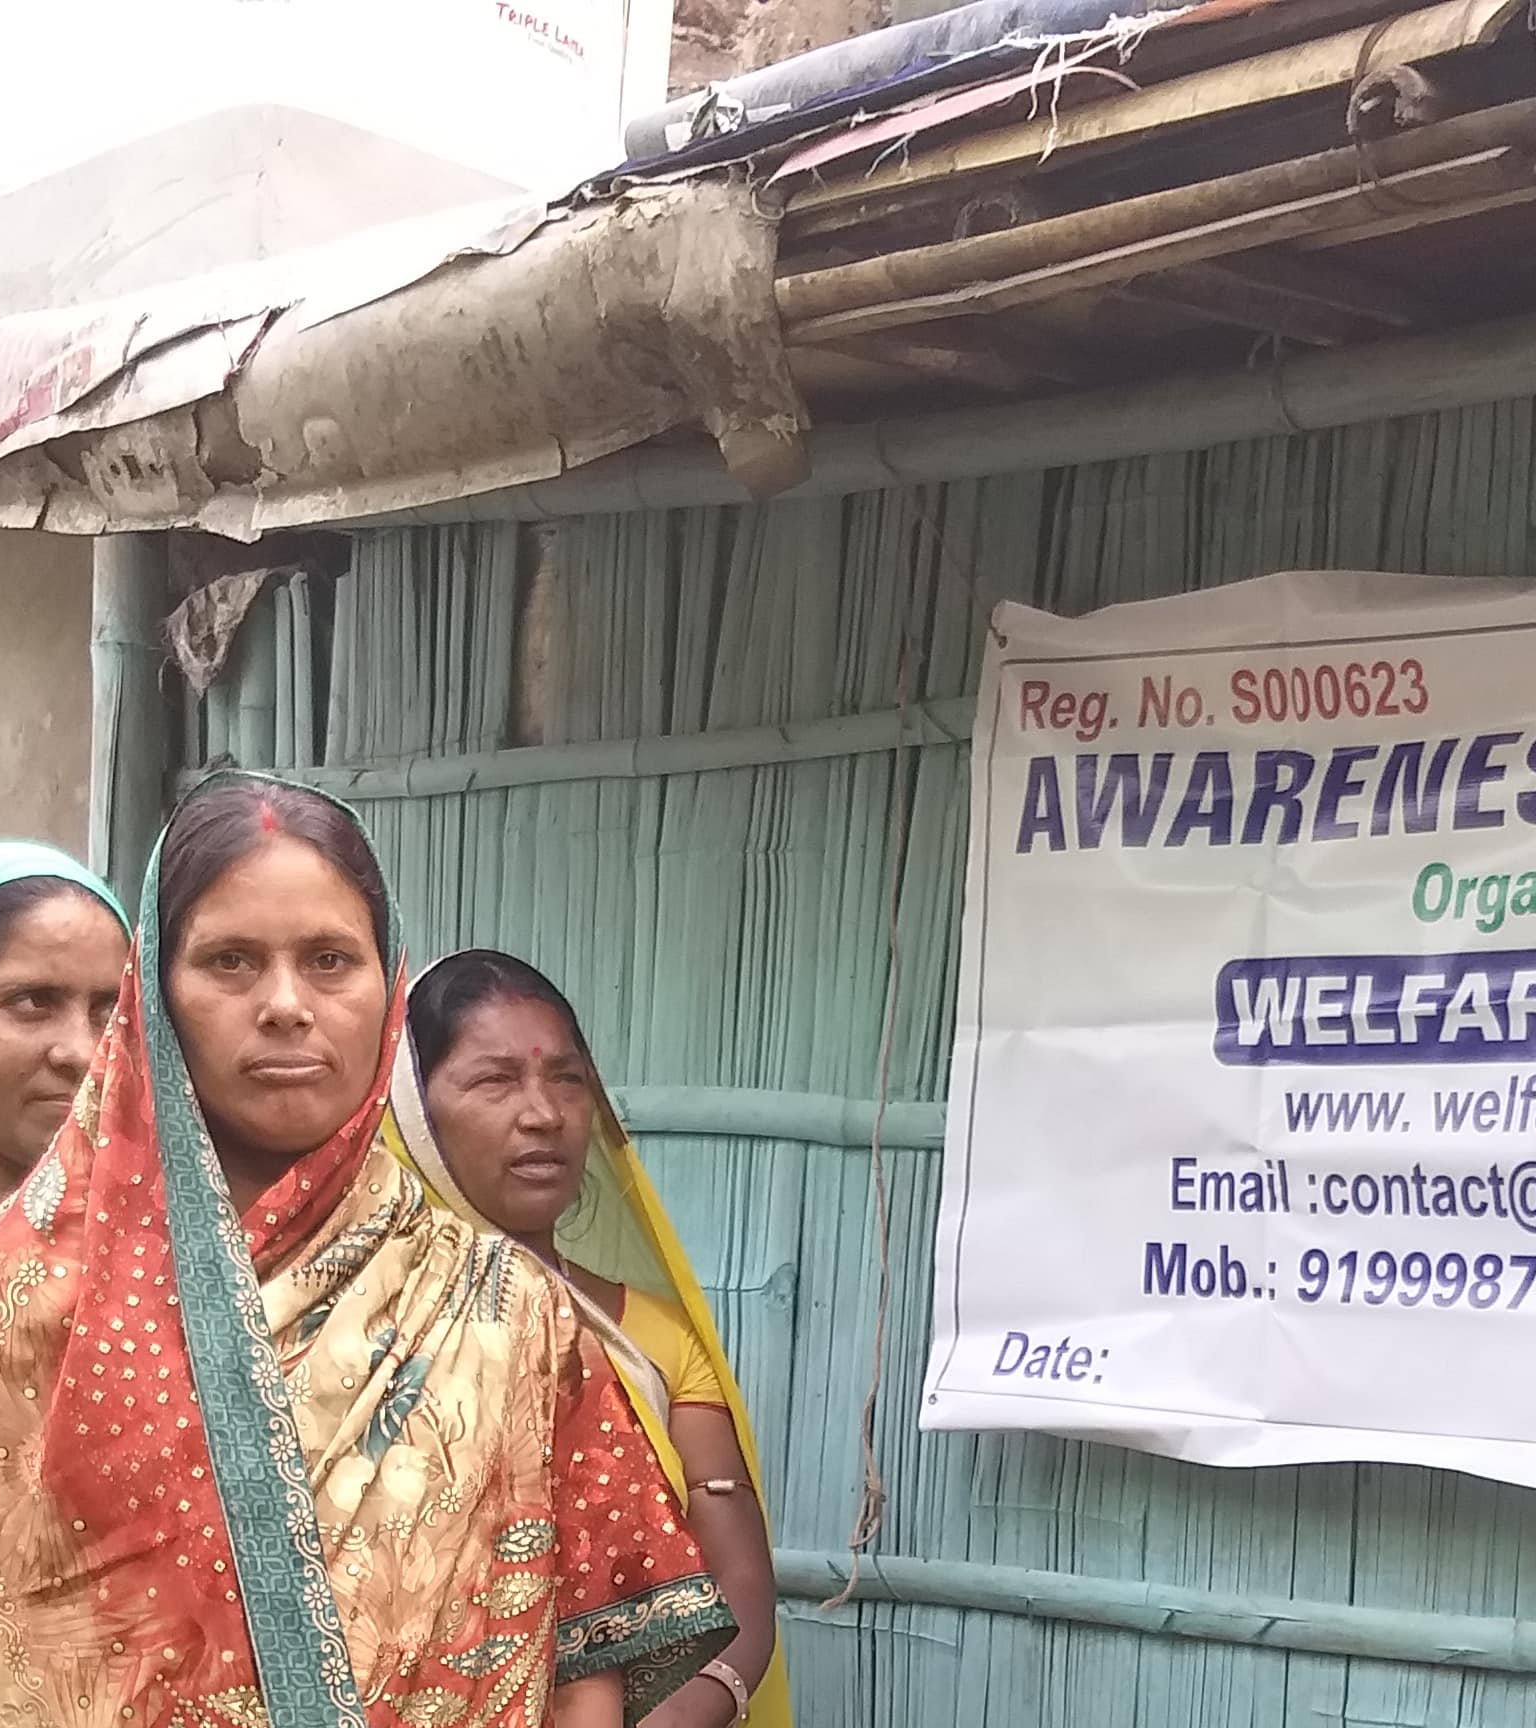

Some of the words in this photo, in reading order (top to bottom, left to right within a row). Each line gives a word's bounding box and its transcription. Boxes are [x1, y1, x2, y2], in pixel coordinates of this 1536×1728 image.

[1020, 680, 1118, 742] Reg.
[1138, 674, 1215, 729] No.
[1231, 659, 1430, 724] S000623
[1284, 1091, 1411, 1134] www.
[1170, 1157, 1291, 1213] Email
[1143, 1242, 1276, 1300] Mob.:
[992, 1331, 1110, 1384] Date:
